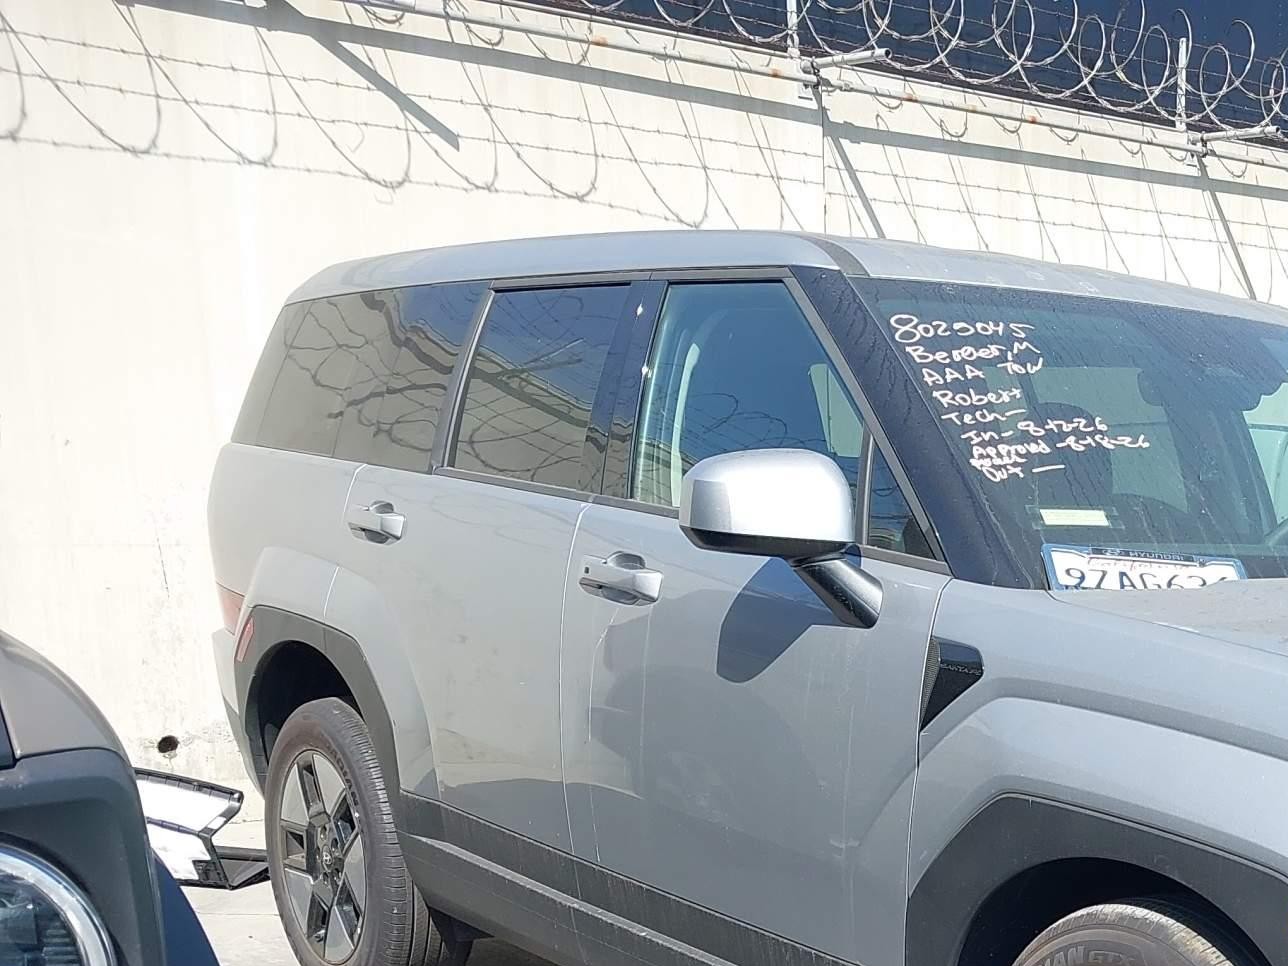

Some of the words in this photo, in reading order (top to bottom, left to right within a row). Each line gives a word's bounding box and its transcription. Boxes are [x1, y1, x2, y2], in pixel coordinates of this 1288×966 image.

[922, 364, 985, 386] AAA
[932, 388, 1022, 407] Robert
[1129, 551, 1184, 562] HYUNDAI
